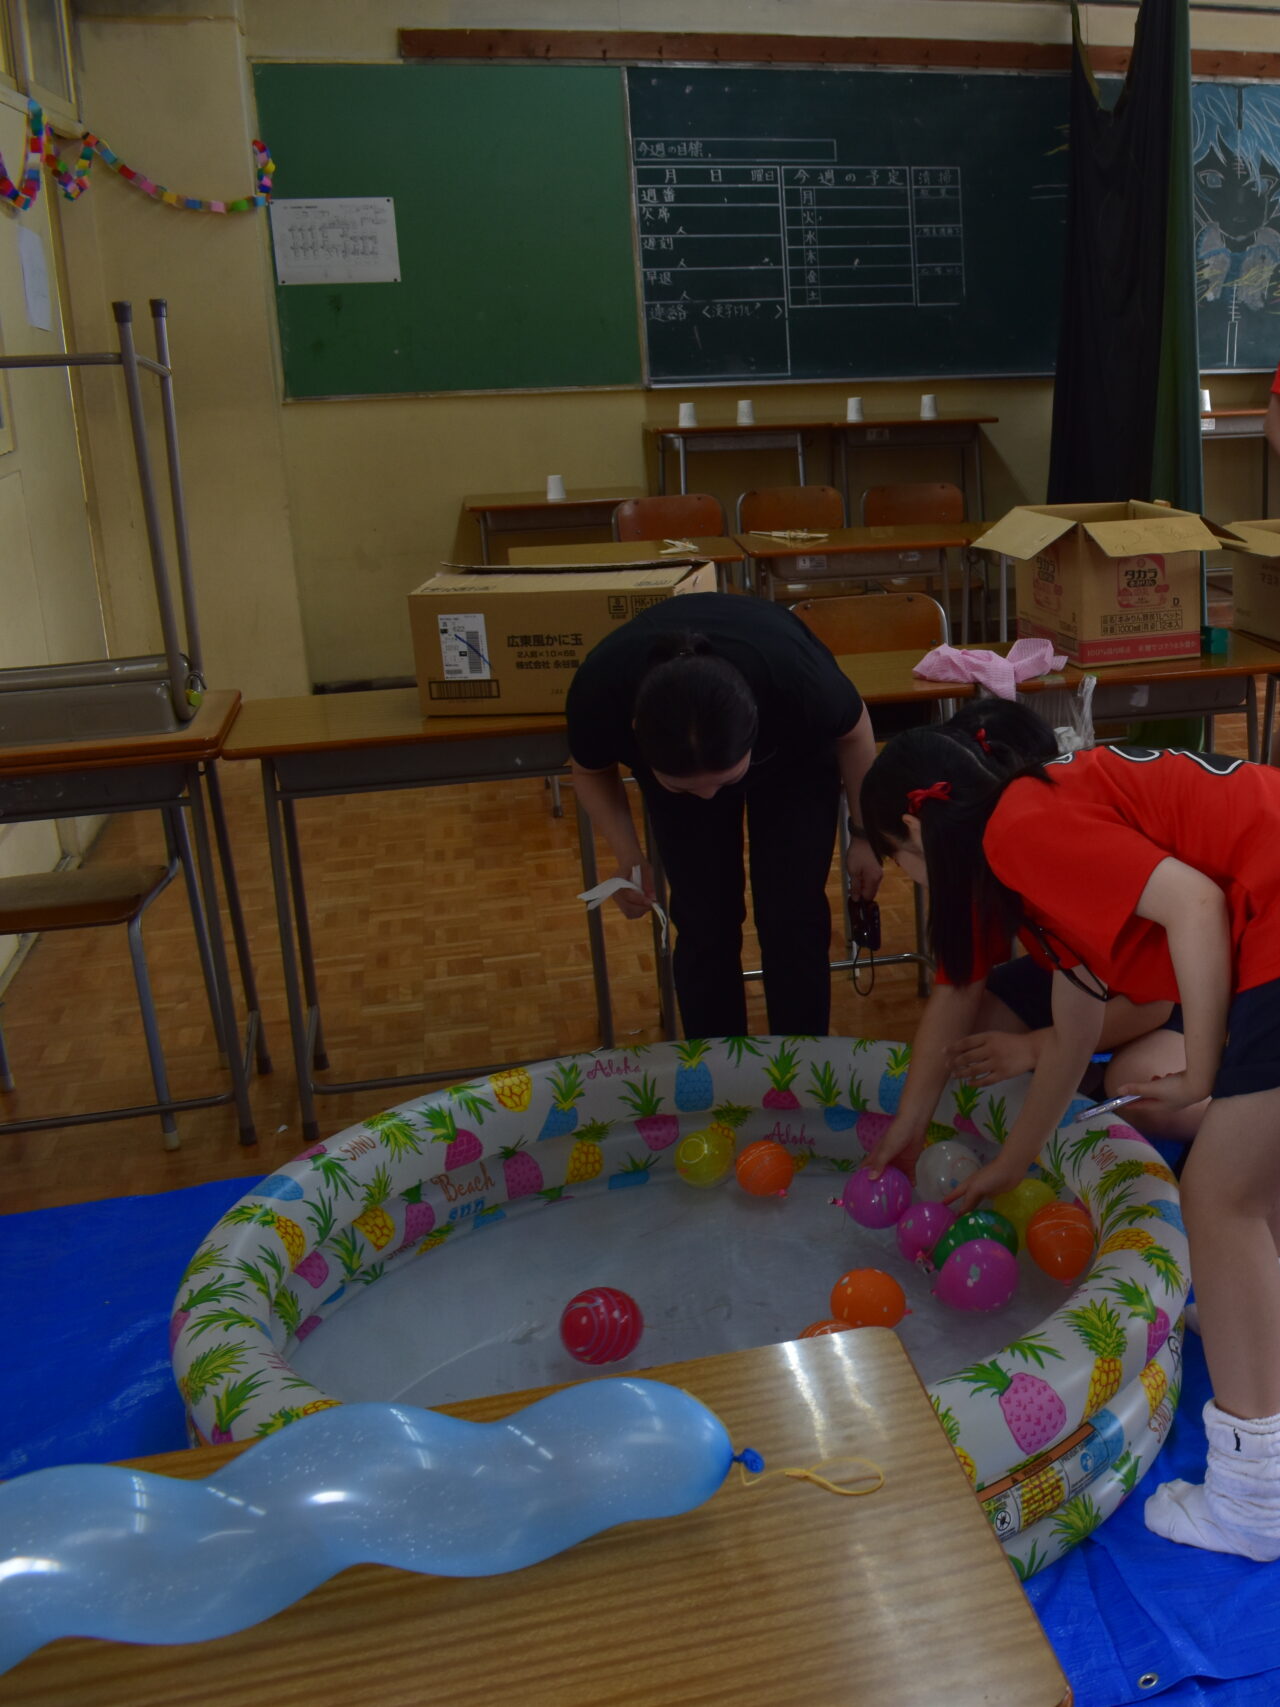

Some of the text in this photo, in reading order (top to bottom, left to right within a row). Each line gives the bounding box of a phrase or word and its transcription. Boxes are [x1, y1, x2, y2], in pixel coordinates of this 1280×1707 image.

[665, 168, 678, 184] 月
[710, 169, 723, 183] 日
[794, 168, 904, 186] 今週の予定
[803, 190, 814, 205] 月
[803, 211, 814, 224] 火
[805, 231, 817, 244] 水
[806, 250, 817, 264] 木
[1124, 568, 1158, 580] タカラ
[1172, 597, 1180, 606] D
[507, 633, 583, 648] 広東風かに玉
[587, 1056, 641, 1079] Aloha
[339, 1135, 376, 1161] SAND
[431, 1161, 495, 1202] Beach
